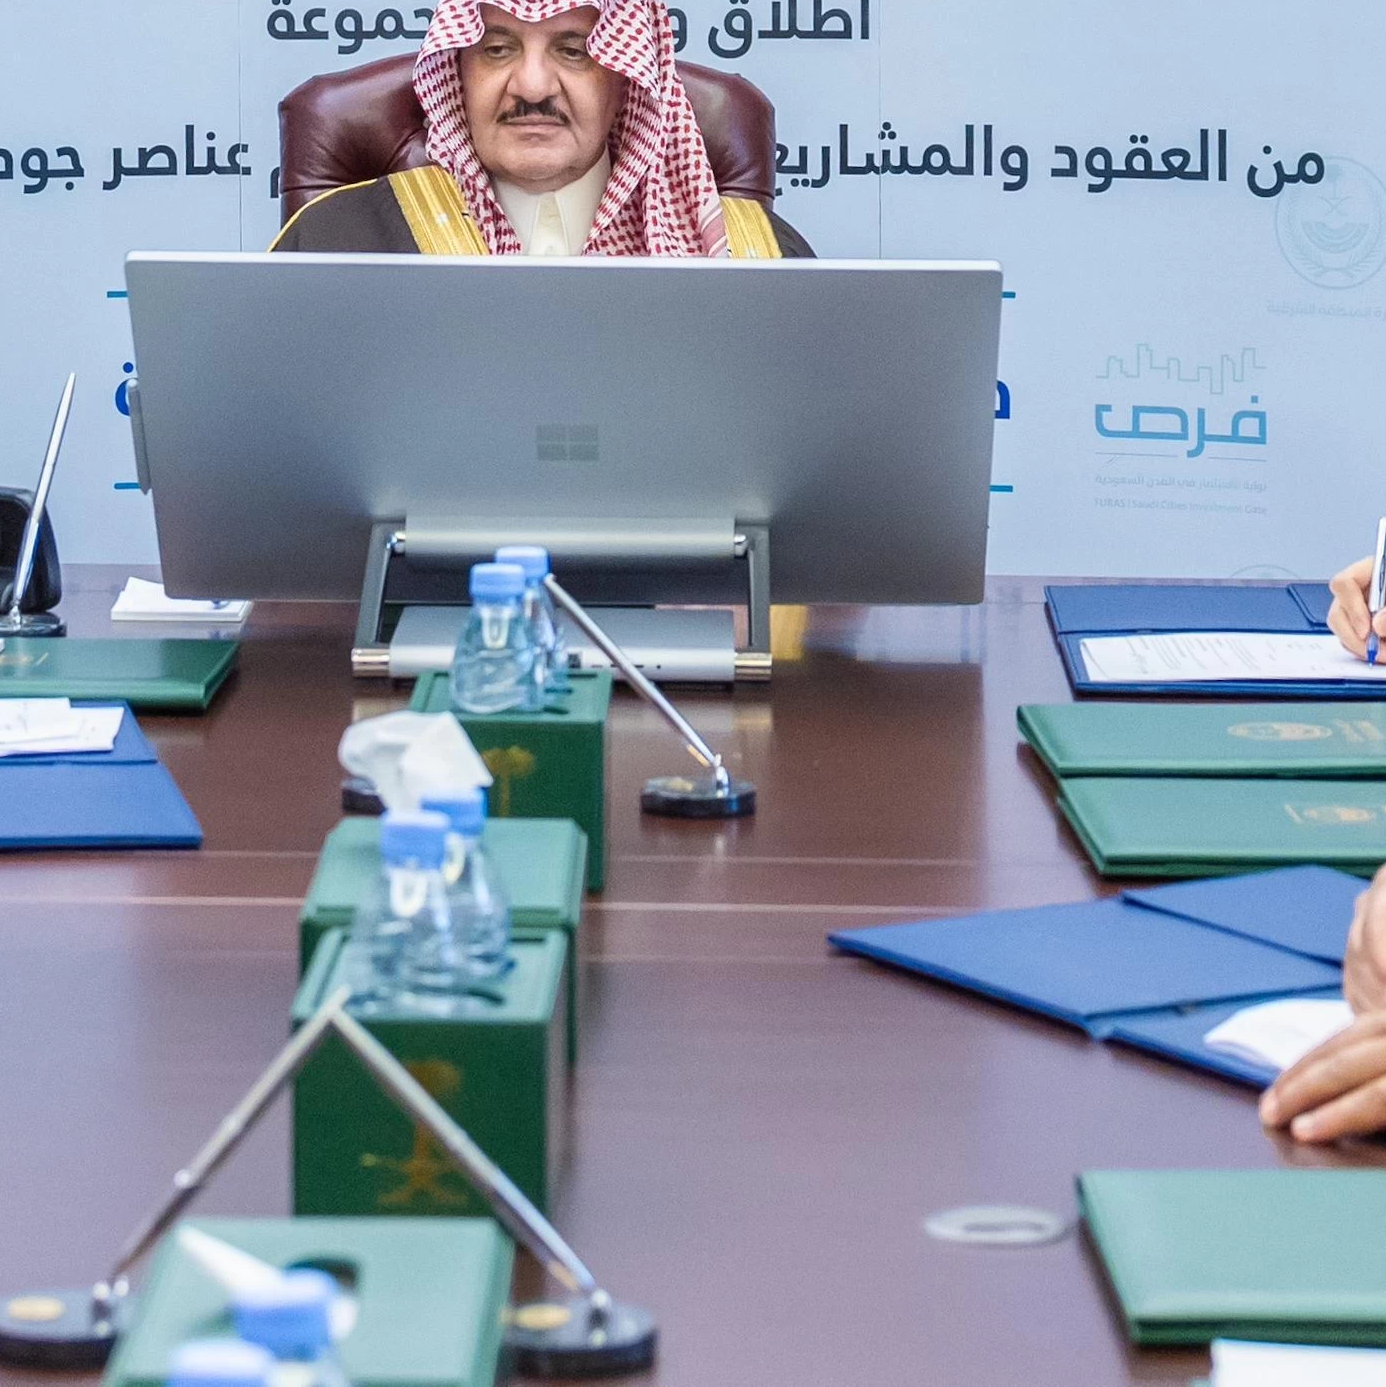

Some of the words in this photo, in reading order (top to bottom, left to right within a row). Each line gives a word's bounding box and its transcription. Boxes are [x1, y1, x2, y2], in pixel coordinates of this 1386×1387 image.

[102, 124, 252, 191] عناصر
[1051, 128, 1228, 193] العقود
[1247, 145, 1326, 198] من
[1094, 395, 1267, 458] فرص
